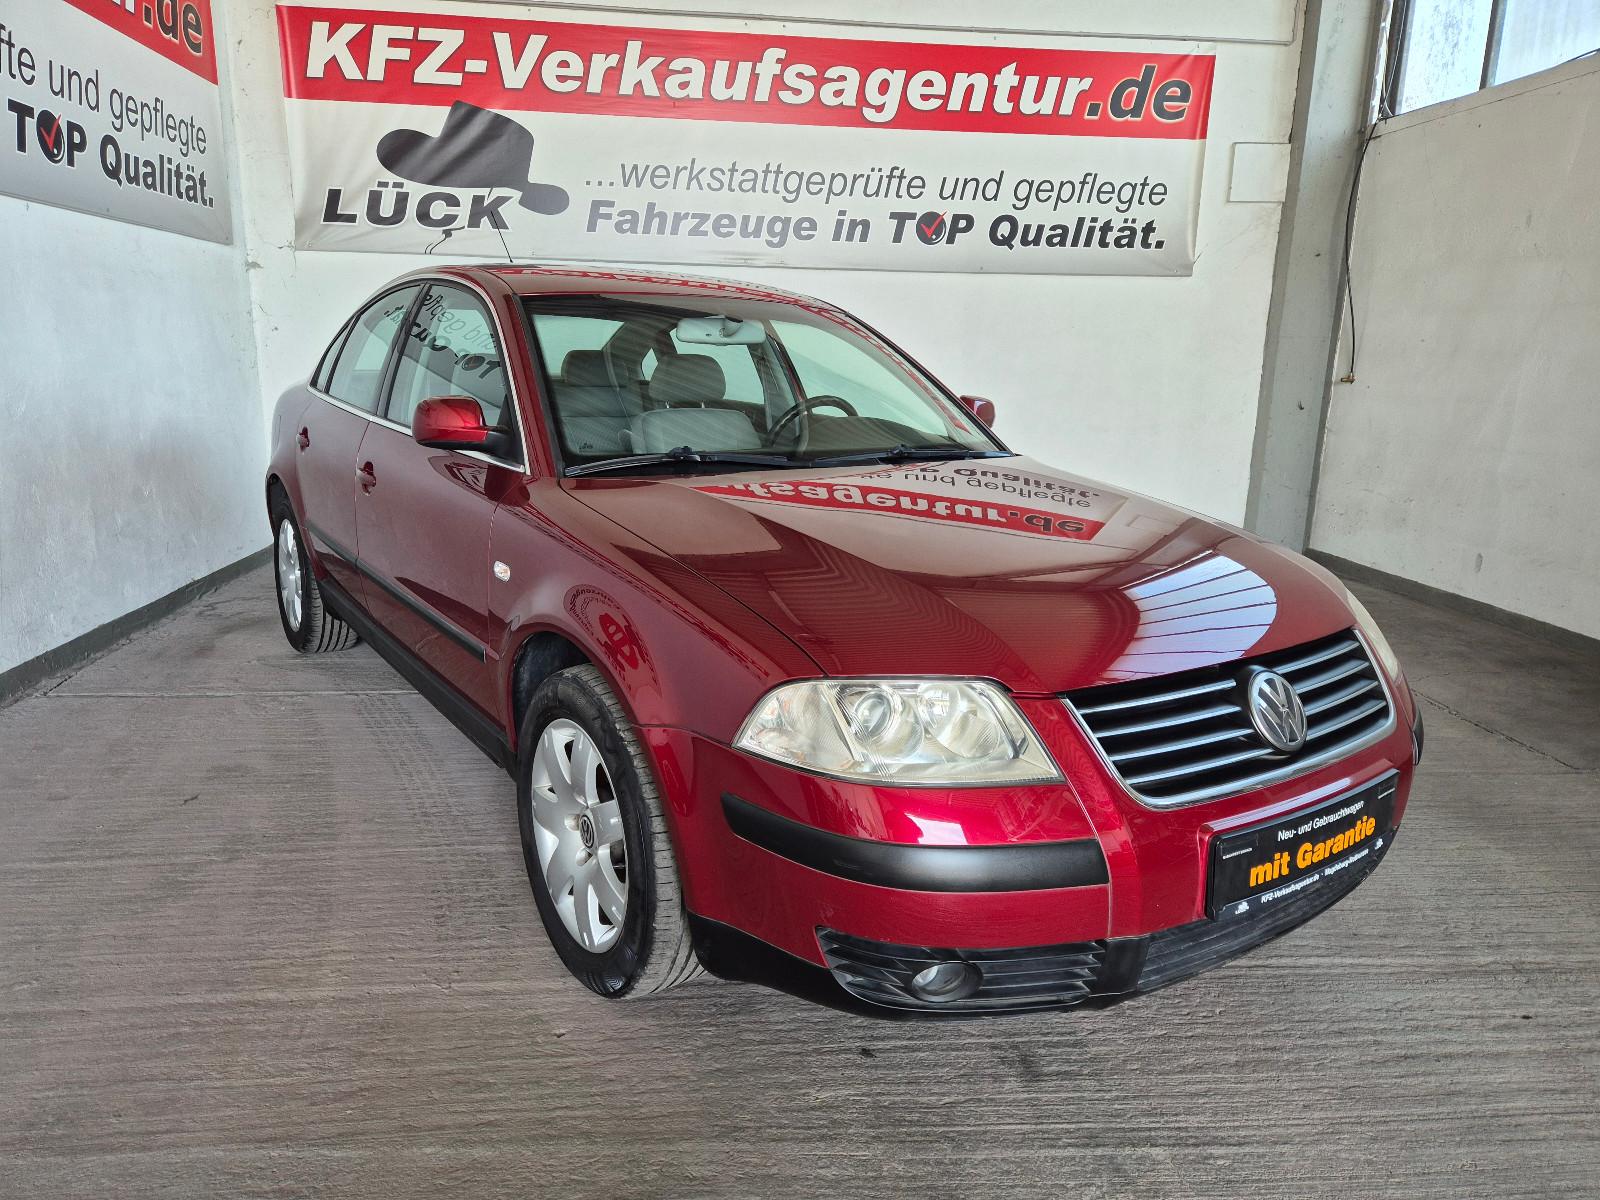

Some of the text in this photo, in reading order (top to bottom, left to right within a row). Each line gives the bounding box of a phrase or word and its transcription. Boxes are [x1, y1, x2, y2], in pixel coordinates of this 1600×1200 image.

[110, 0, 203, 55] .de
[306, 21, 1192, 123] KFZ-Verkaufsagentur.de
[49, 60, 99, 112] und
[109, 88, 207, 157] gepflegte
[8, 99, 214, 208] TOP Qualität.
[322, 181, 514, 230] LÜCK
[938, 171, 1005, 202] und
[1012, 174, 1168, 211] gepflegte
[586, 200, 1166, 250] Fahrzeuge in TOP Qualität.
[1278, 801, 1365, 841] Neu- und Gebrauchtwagen
[1249, 852, 1291, 887] mit
[1296, 816, 1376, 869] Garantie
